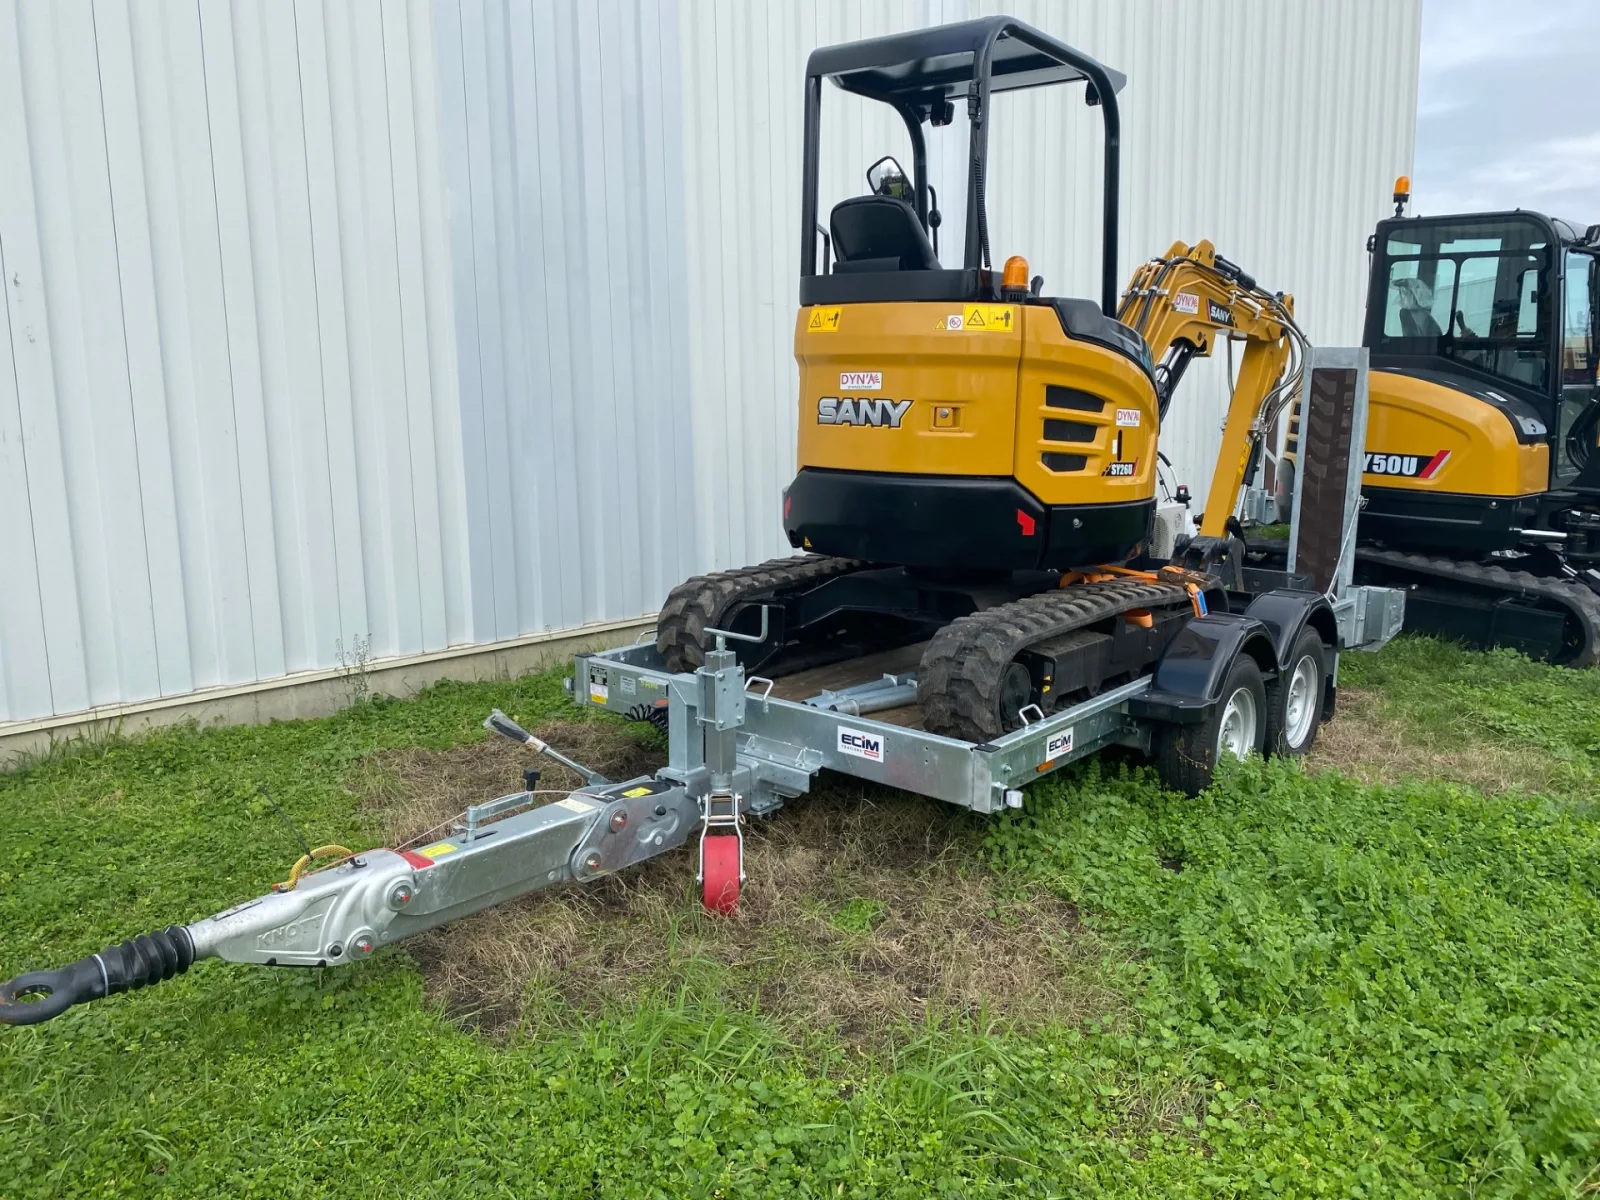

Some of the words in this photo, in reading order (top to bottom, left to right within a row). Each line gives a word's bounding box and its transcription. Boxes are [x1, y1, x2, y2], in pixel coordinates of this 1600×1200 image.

[1210, 305, 1231, 323] SANY
[818, 397, 914, 428] SANY
[1110, 463, 1133, 476] SY26U
[256, 913, 324, 950] KNOTT
